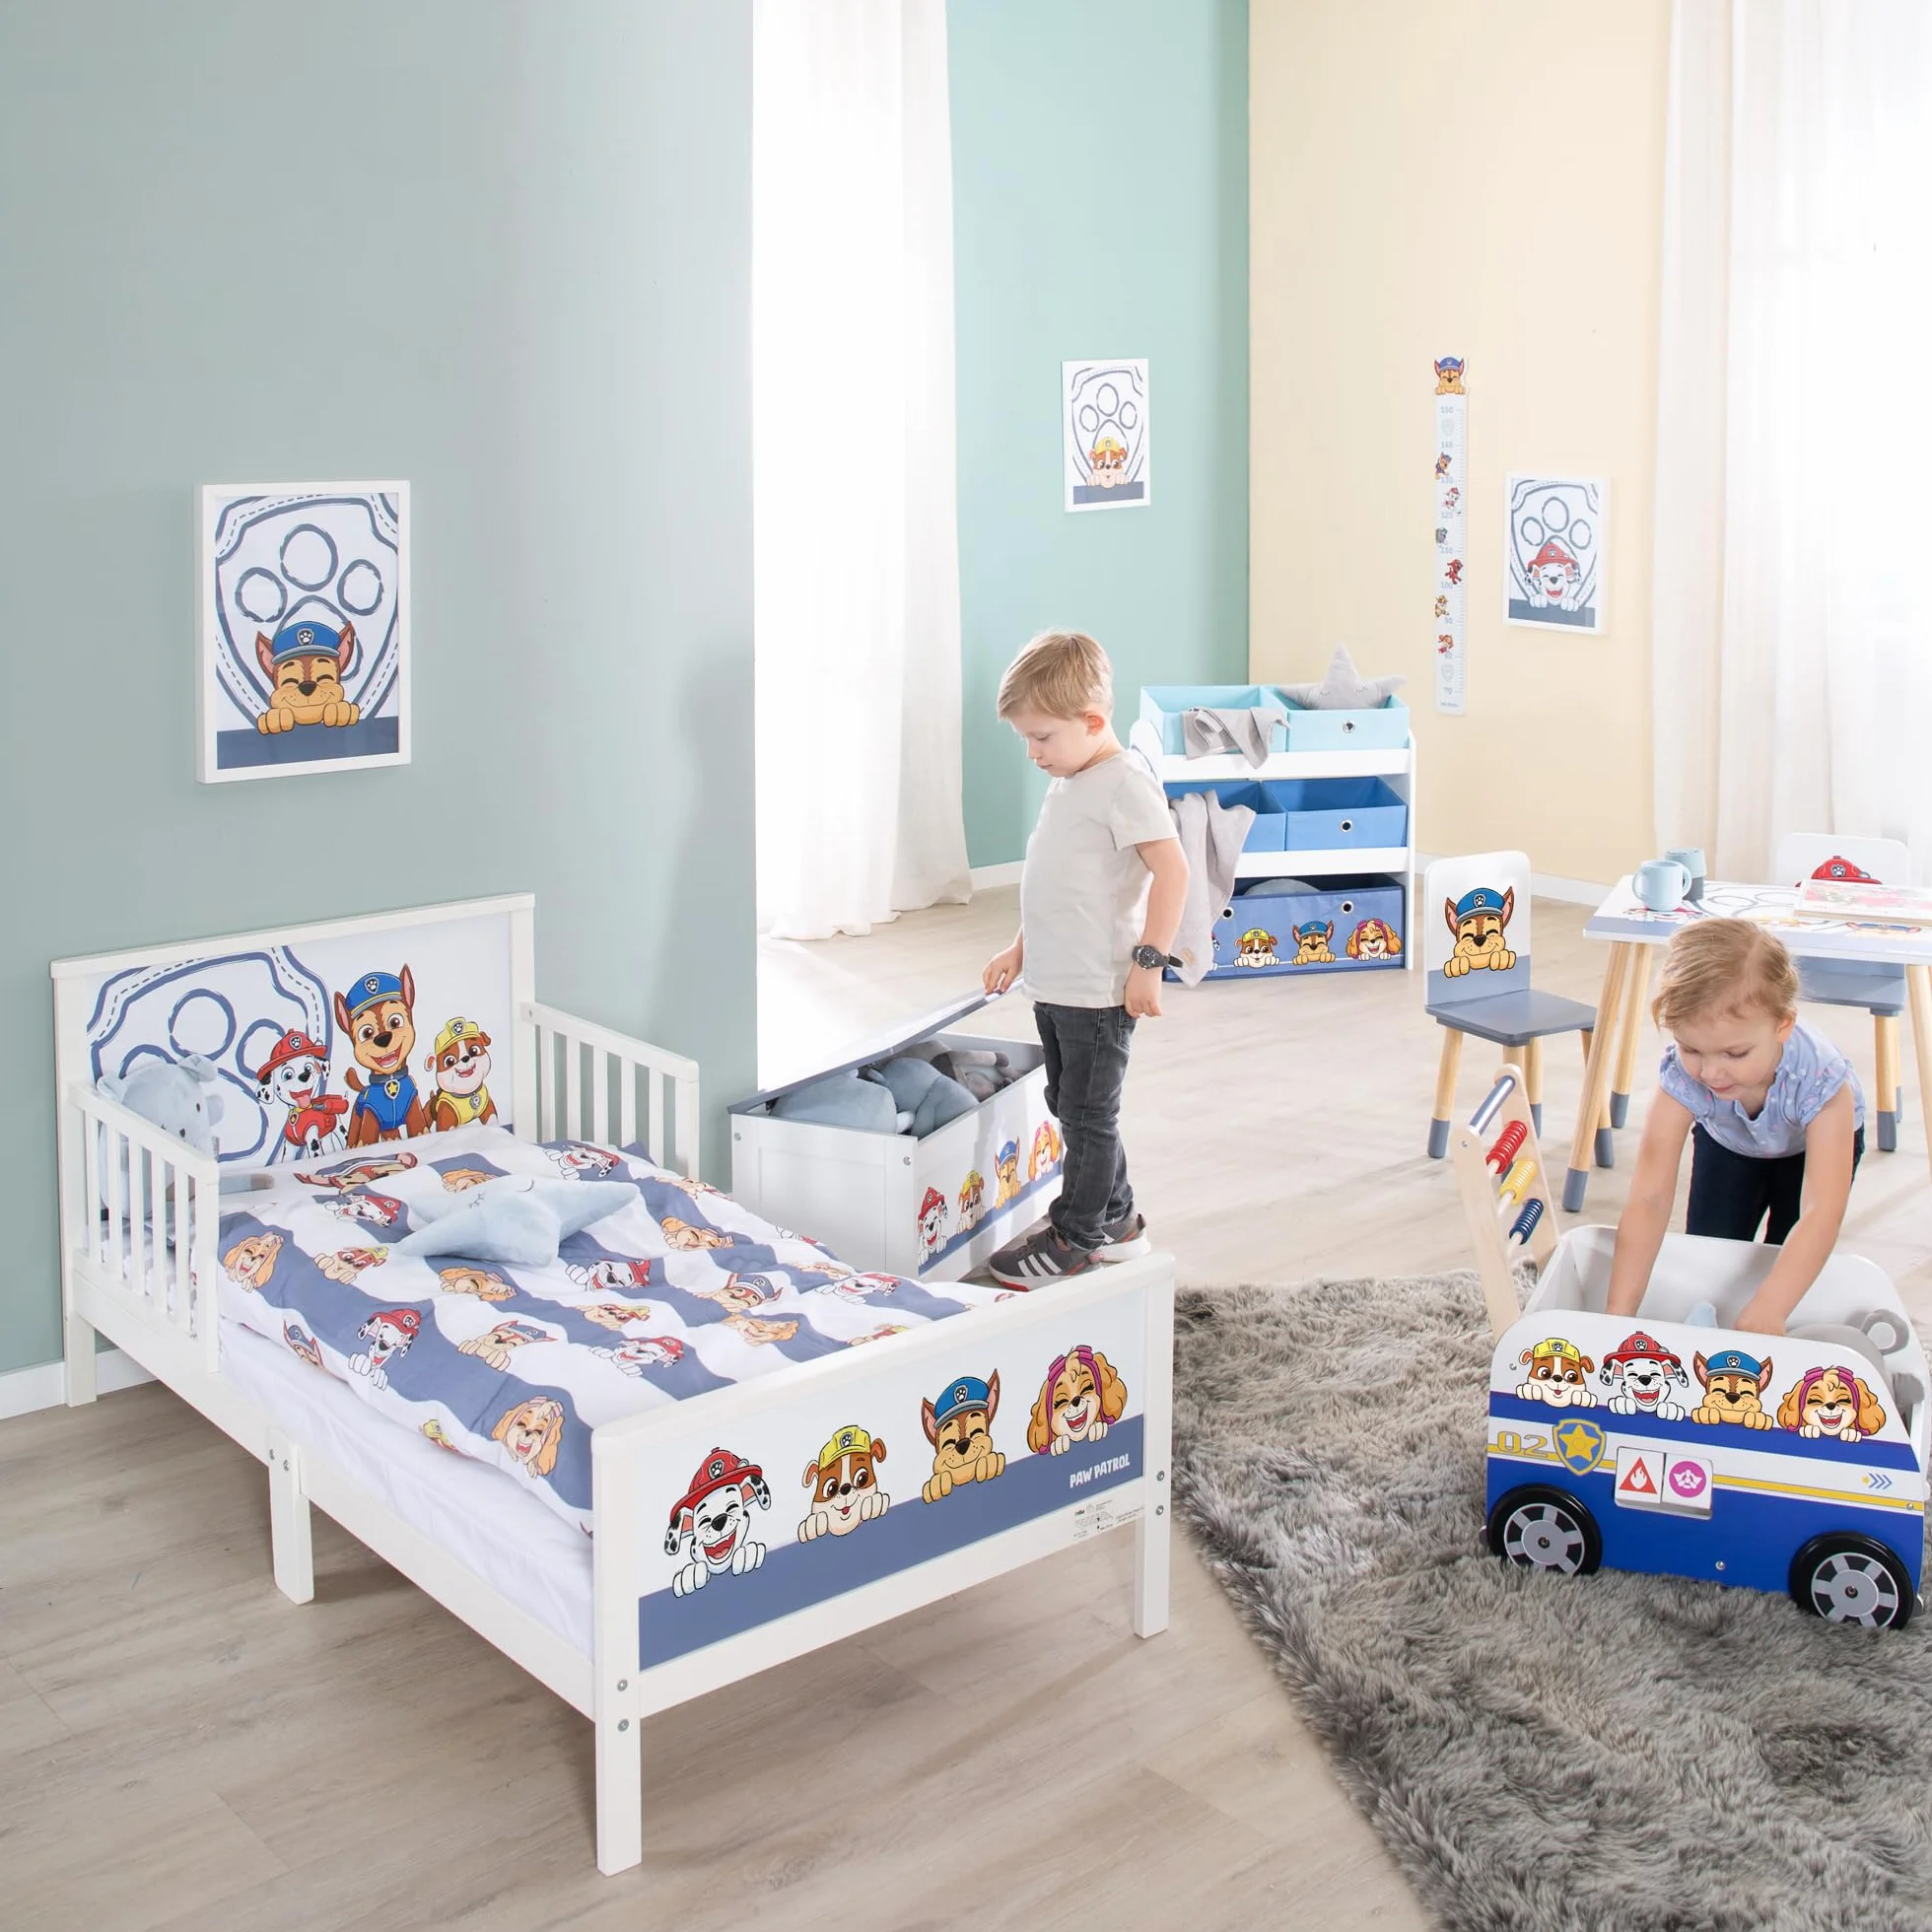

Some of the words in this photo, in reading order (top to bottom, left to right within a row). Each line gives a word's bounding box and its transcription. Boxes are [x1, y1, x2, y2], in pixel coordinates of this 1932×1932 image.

[1497, 1430, 1549, 1459] 02
[1070, 1467, 1093, 1488] PAW
[1094, 1453, 1131, 1479] PATROL
